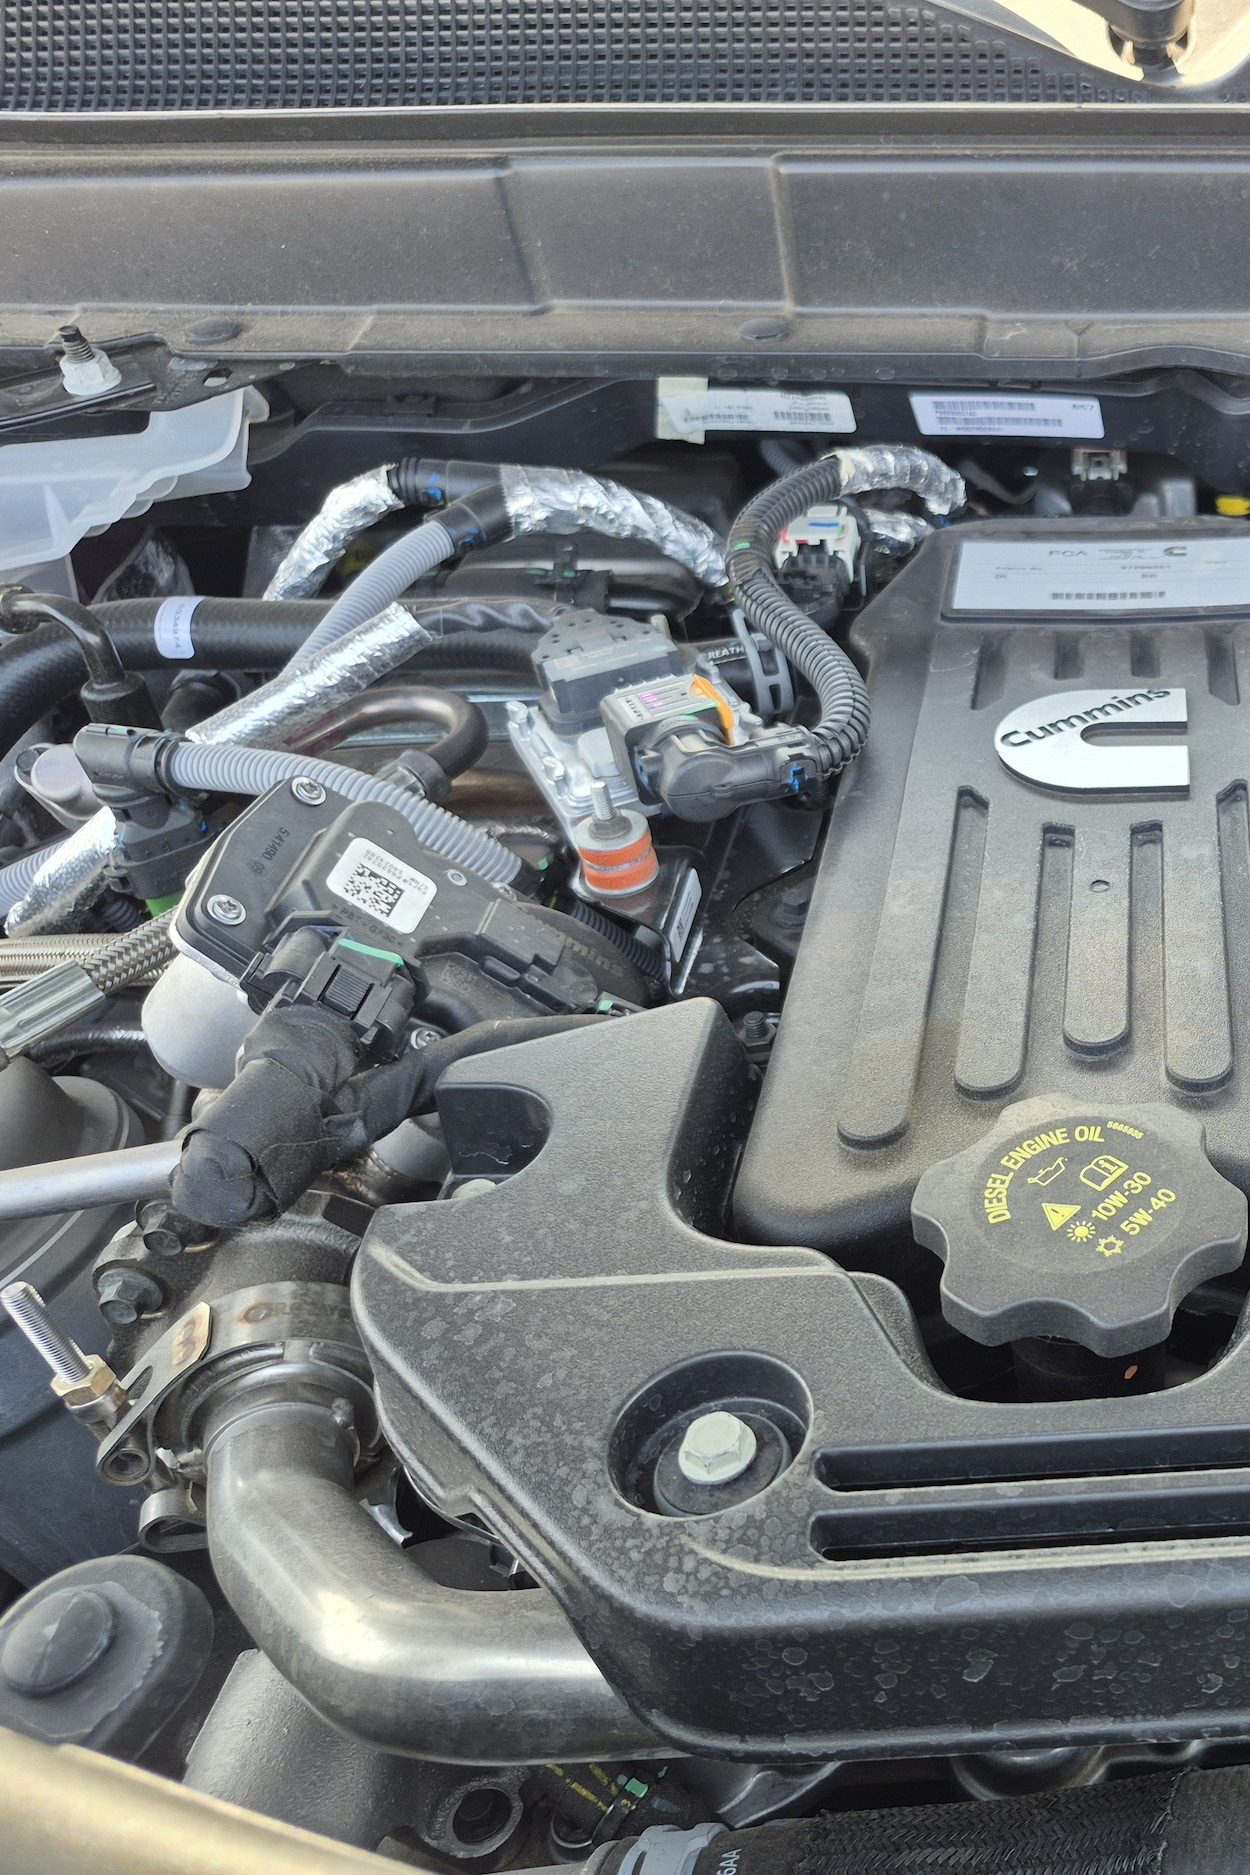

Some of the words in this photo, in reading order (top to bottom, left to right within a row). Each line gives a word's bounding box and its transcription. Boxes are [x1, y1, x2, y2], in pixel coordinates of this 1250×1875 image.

[1001, 689, 1171, 747] Cummins
[984, 1171, 1014, 1224] DIESEL
[1000, 1128, 1070, 1170] ENGINE
[1074, 1126, 1105, 1142] OIL
[1092, 1172, 1151, 1221] 10W-30
[1120, 1188, 1176, 1235] 5W-40
